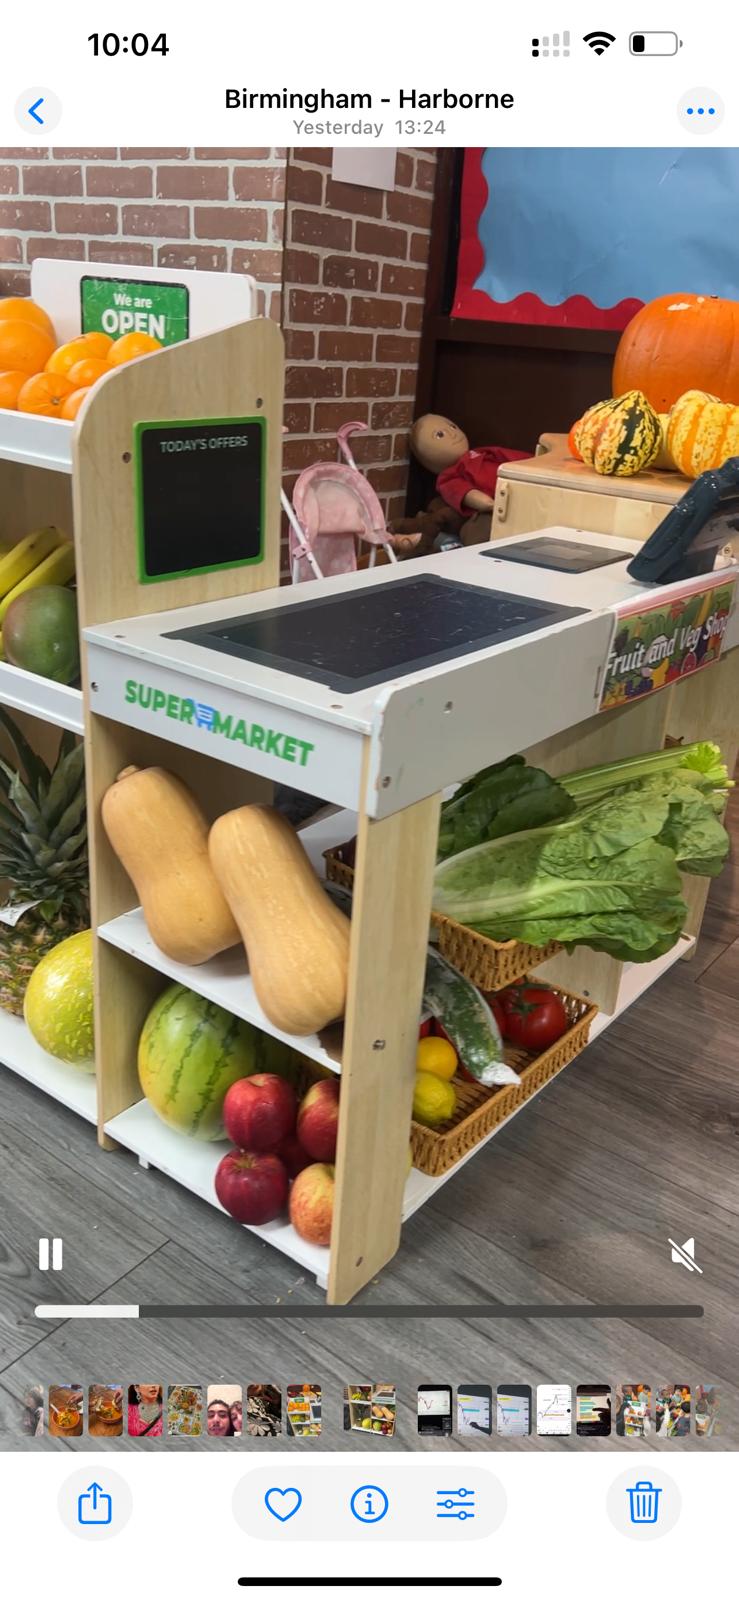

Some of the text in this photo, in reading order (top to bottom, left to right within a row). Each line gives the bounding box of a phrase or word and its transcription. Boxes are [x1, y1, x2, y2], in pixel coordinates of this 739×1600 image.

[113, 293, 153, 309] We are
[102, 309, 166, 339] OPEN
[160, 435, 249, 453] TODAY'S OFFERS
[649, 628, 678, 663] and
[680, 625, 702, 652] Veg
